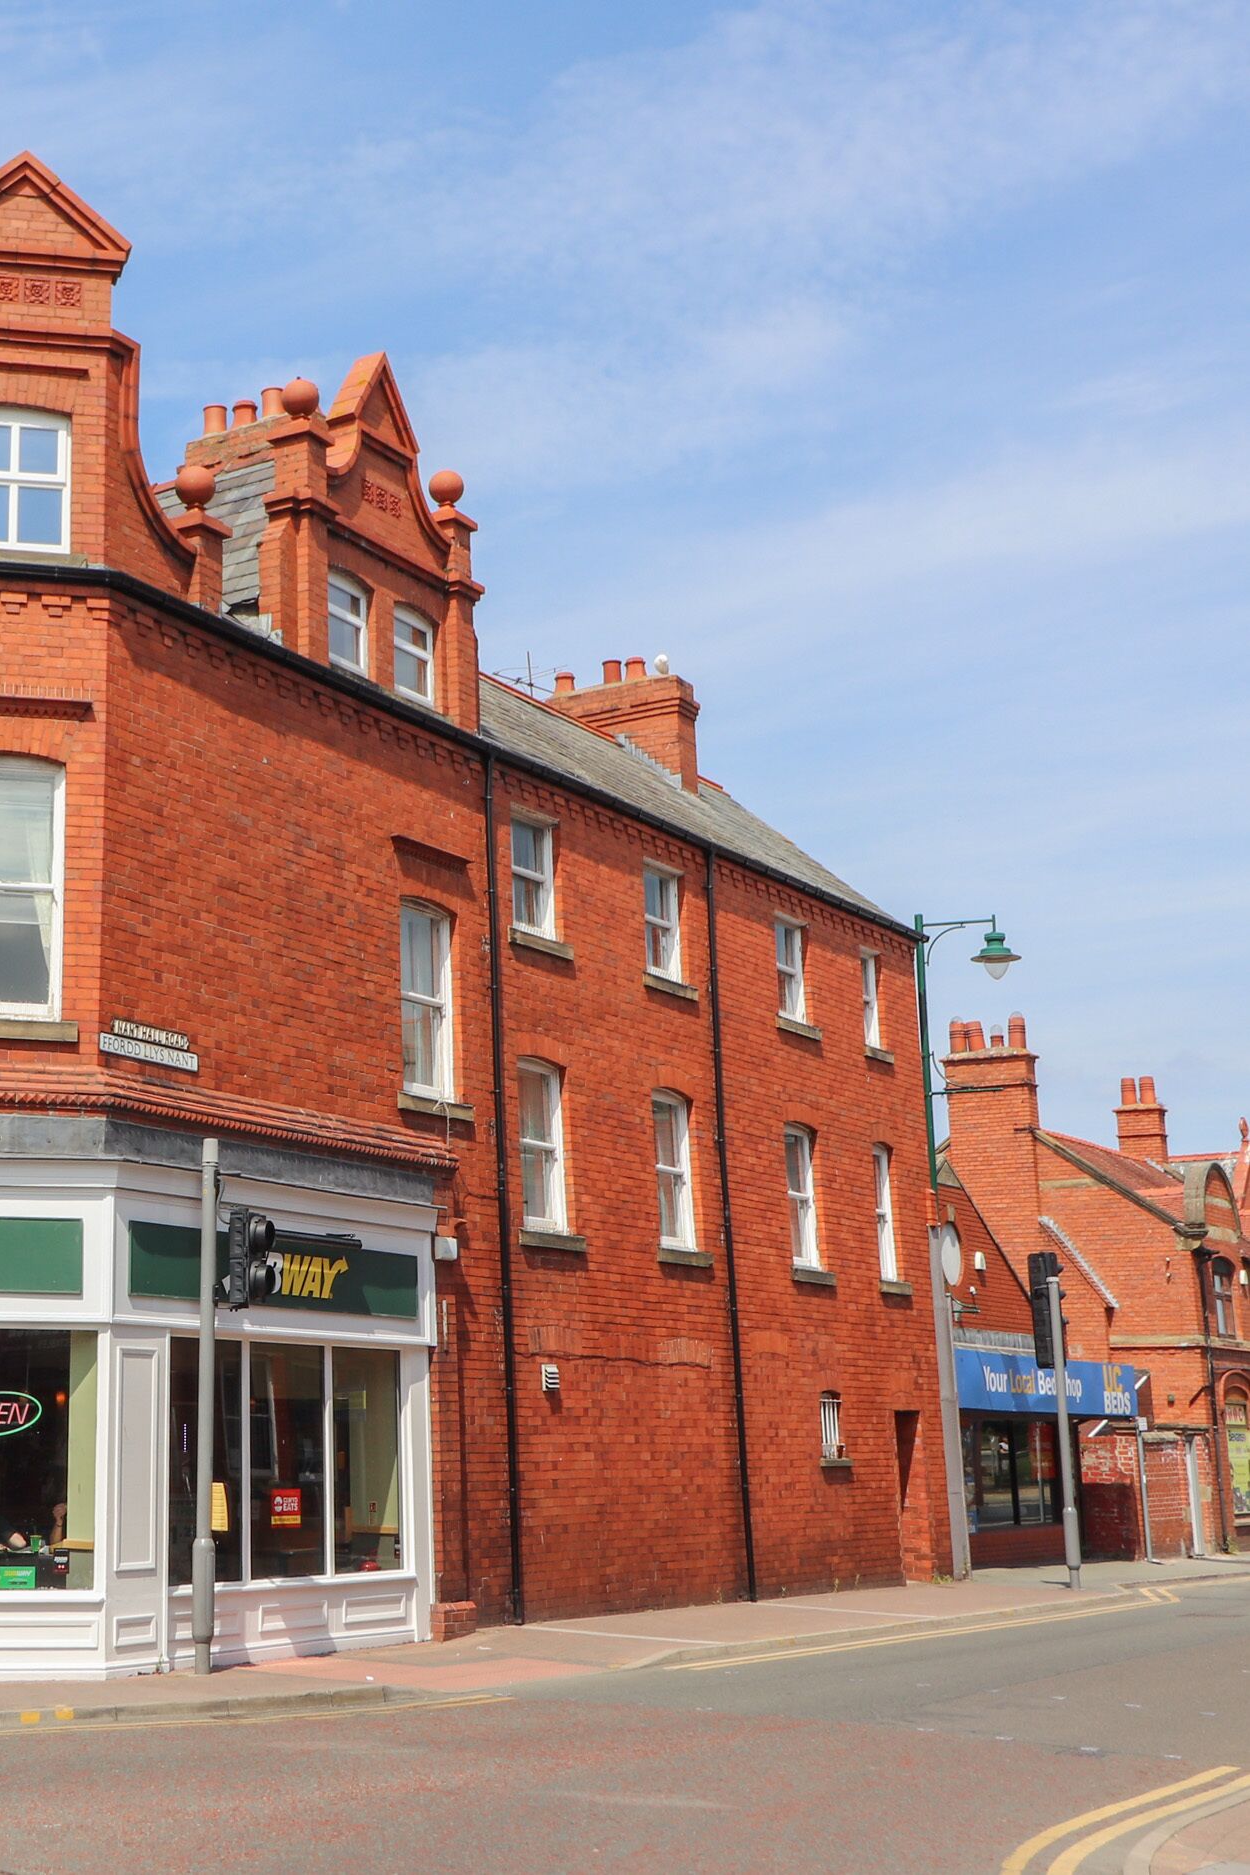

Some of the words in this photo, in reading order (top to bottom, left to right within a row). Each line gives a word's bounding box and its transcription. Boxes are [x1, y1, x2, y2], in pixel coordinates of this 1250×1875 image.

[116, 1020, 139, 1038] NANT
[141, 1026, 162, 1043] HALL
[164, 1031, 185, 1049] ROAD
[102, 1036, 141, 1055] FFORDD
[144, 1045, 165, 1062] LLYS
[167, 1051, 195, 1068] NANT
[983, 1366, 1008, 1393] Your
[1009, 1369, 1036, 1394] Local
[1037, 1371, 1056, 1395] Bed
[1065, 1371, 1082, 1403] hop
[1102, 1365, 1124, 1392] UC
[1104, 1391, 1131, 1415] BEDS
[283, 1503, 299, 1511] EATS
